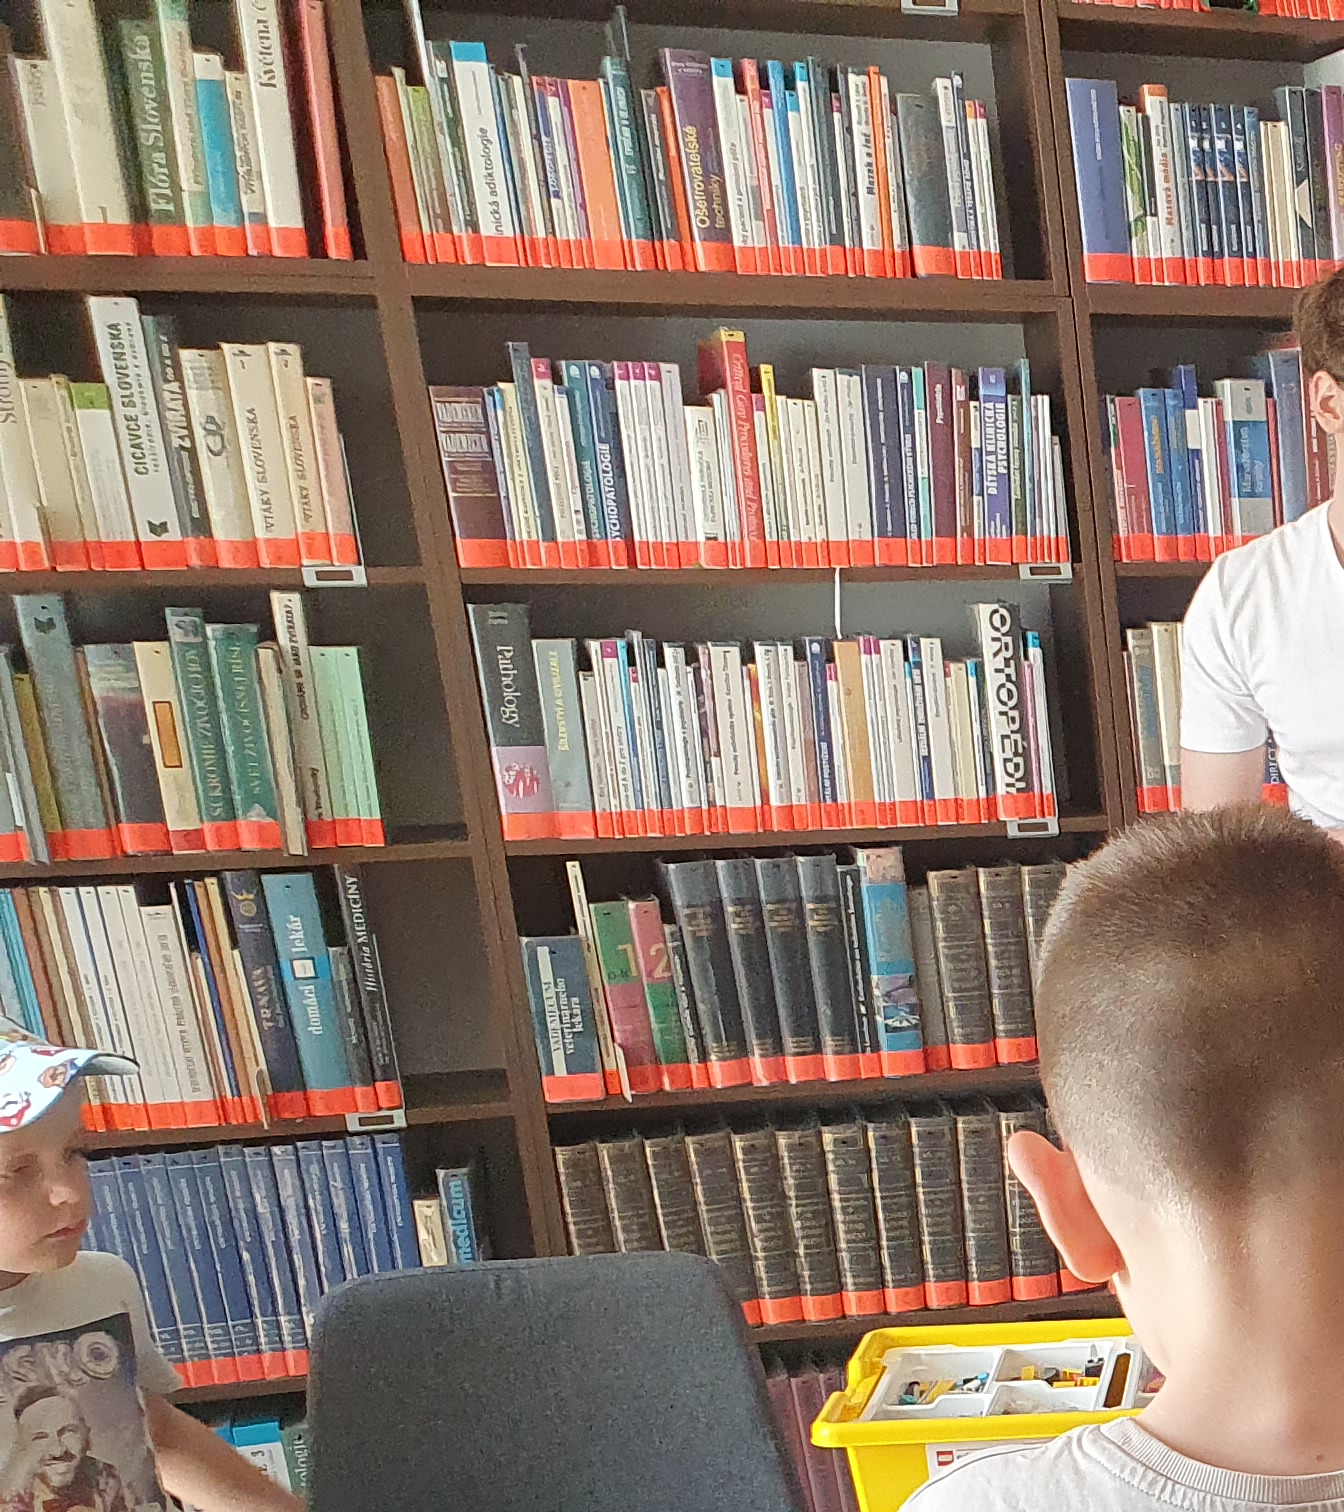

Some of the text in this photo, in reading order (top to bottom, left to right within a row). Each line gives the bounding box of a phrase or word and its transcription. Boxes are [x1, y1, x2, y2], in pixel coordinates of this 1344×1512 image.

[127, 35, 175, 214] Flóra Slovenska
[477, 126, 504, 236] inická adiktologie
[709, 174, 726, 228] techniky
[105, 321, 138, 408] SLOVENSKA
[124, 413, 150, 476] CICAVCE
[245, 407, 267, 484] SLOVENSKA
[994, 402, 1008, 474] PSYCHOLOGIE
[496, 645, 522, 728] Pathology
[989, 607, 1027, 796] ORTOPÉDI
[286, 914, 308, 953] lekár
[345, 874, 379, 992] História MEDICÍNY
[616, 943, 639, 977] 1
[648, 942, 672, 979] 2
[289, 1433, 308, 1487] ologie
